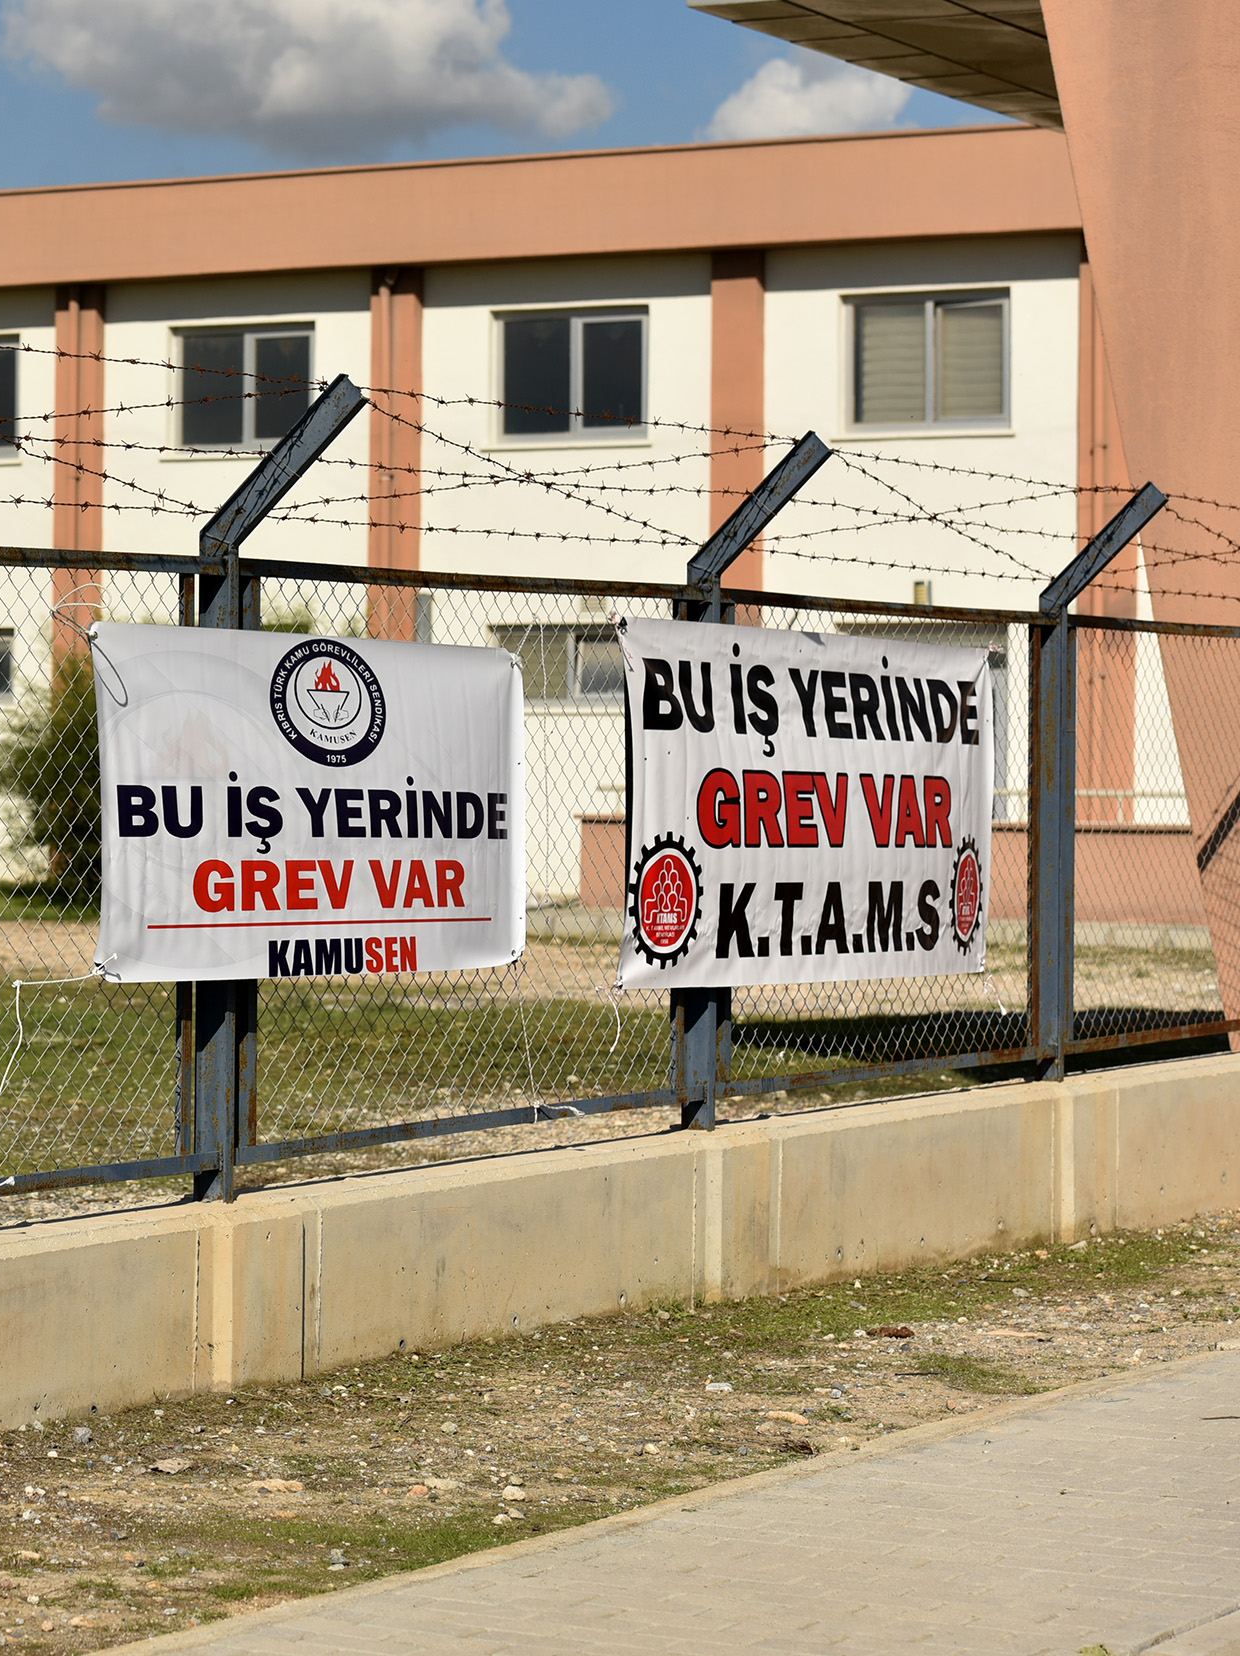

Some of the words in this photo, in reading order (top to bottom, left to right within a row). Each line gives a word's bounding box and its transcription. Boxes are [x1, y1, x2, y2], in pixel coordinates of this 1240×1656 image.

[284, 646, 310, 671] KAMU
[312, 643, 374, 683] GÖREVLİLERİ
[274, 670, 288, 698] TÜRK
[642, 657, 715, 733] BU
[730, 643, 779, 757] İŞ
[788, 656, 979, 745] YERİNDE
[275, 704, 298, 740] KIBRIS
[368, 684, 383, 743] SENDİKASI
[310, 729, 357, 744] KAMUSEN
[326, 755, 346, 763] 1975
[117, 785, 203, 838] BU
[227, 771, 283, 854] İŞ
[295, 776, 508, 840] YERİNDE
[697, 768, 848, 848] GREV
[860, 774, 952, 848] VAR
[193, 859, 354, 912] GREV
[369, 859, 465, 908] VAR
[715, 880, 940, 958] K.T.A.M.S
[268, 936, 417, 977] KAMUSEN
